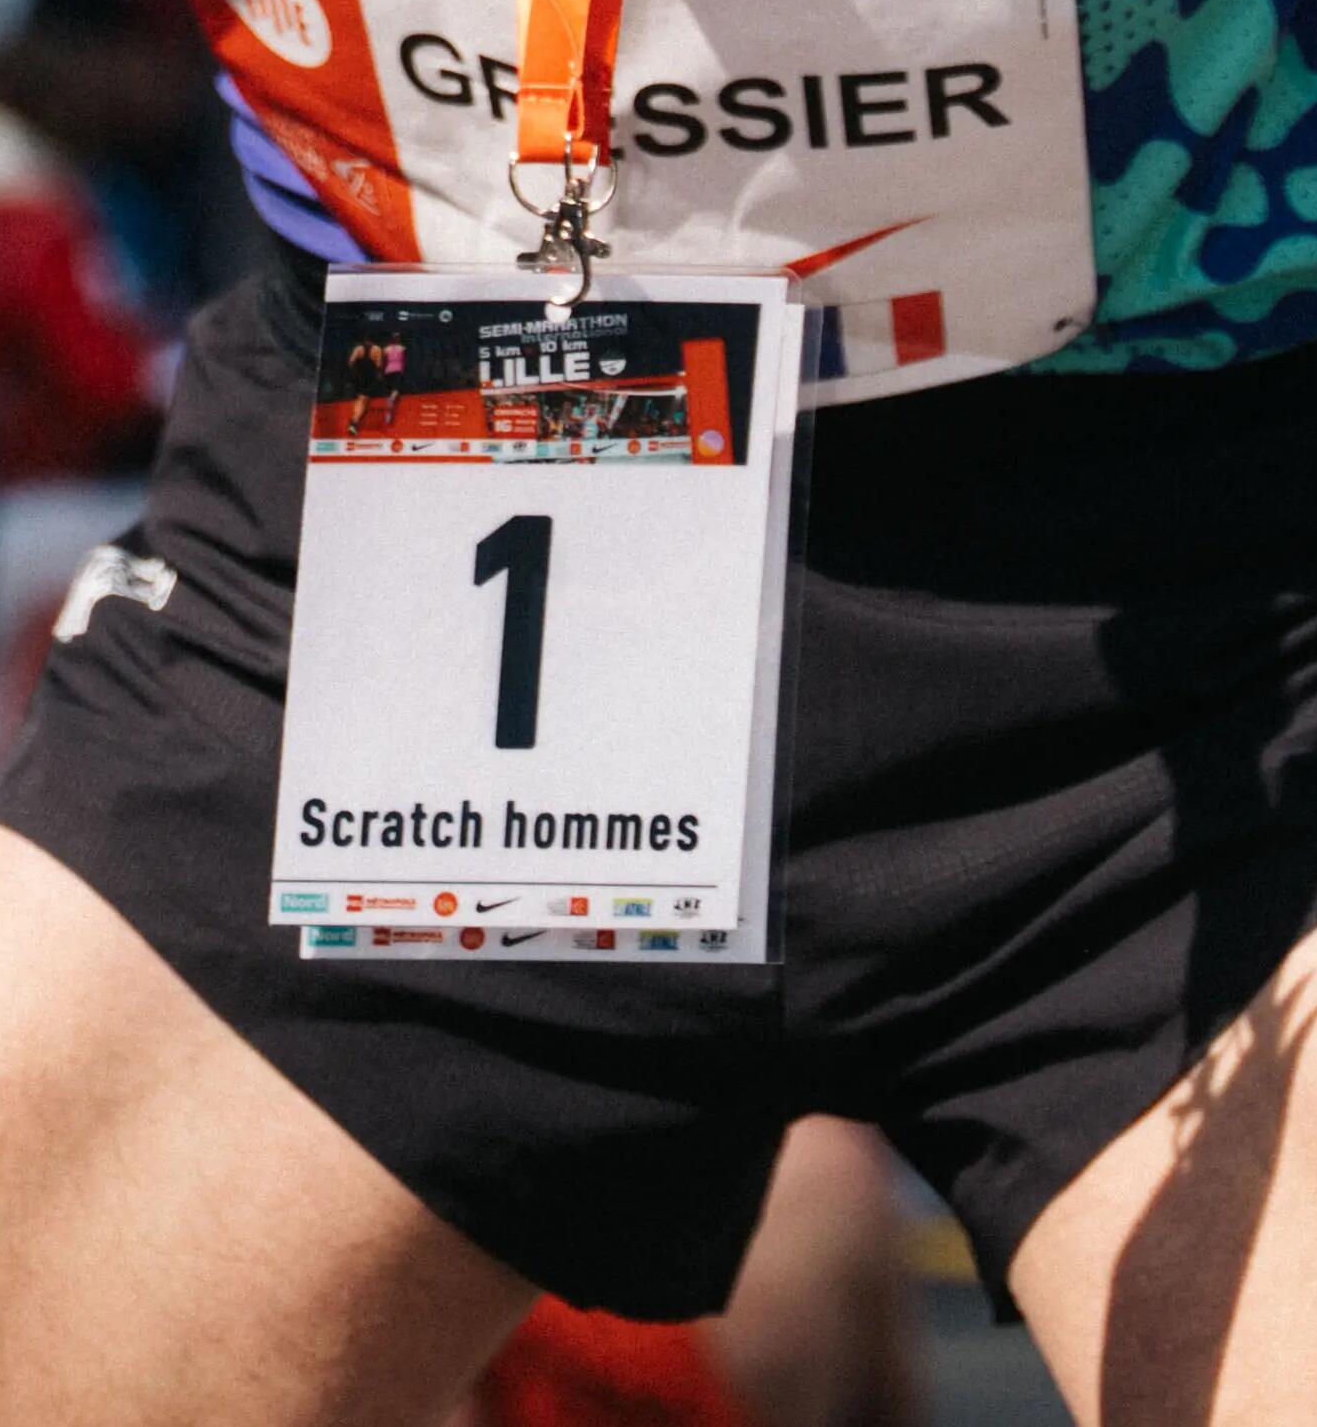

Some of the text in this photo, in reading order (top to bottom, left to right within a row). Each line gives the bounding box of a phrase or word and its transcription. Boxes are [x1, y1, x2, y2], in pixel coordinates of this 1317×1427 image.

[478, 351, 591, 389] LILLE
[479, 340, 588, 359] 5 km 10 km
[473, 514, 553, 749] 1
[299, 797, 701, 852] Scratch hommes
